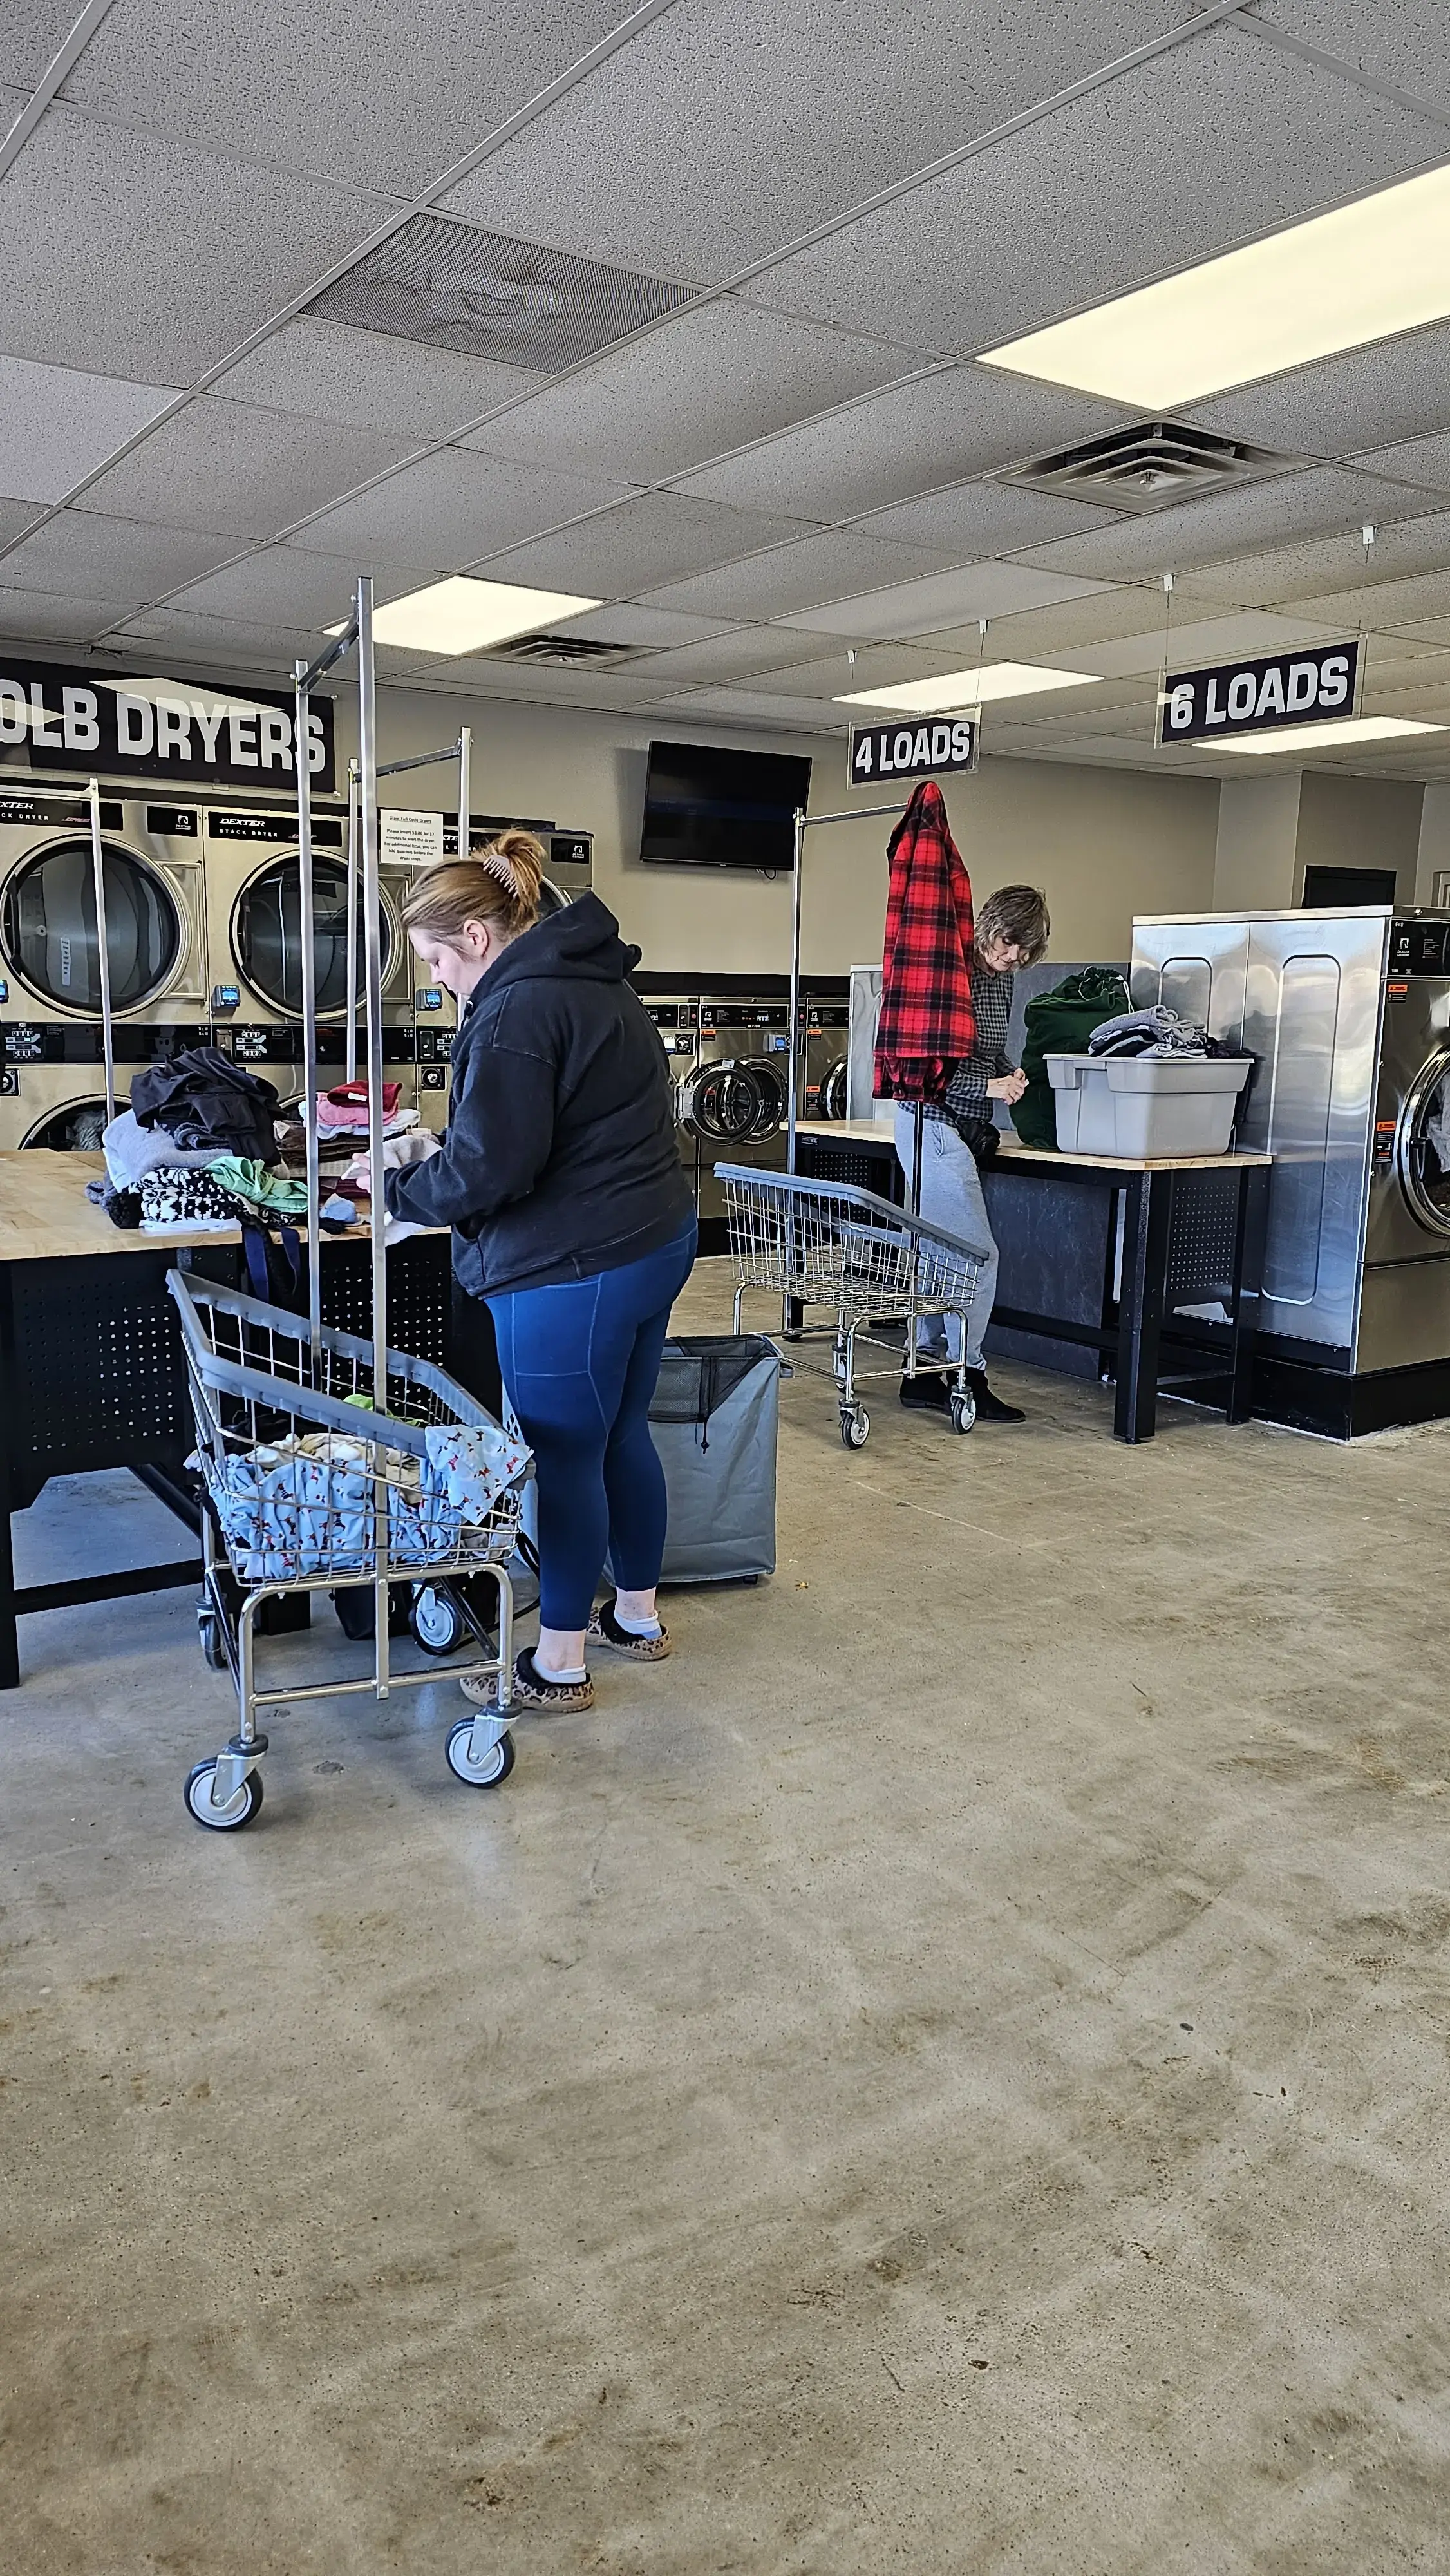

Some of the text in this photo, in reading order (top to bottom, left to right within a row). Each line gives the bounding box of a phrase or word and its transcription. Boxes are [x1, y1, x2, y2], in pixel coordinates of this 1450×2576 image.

[1170, 656, 1348, 729] 6 LOADS
[116, 692, 326, 773] DRYERS
[856, 722, 970, 773] 4 LOADS
[0, 801, 33, 810] XTER
[219, 817, 265, 827] DEXTER
